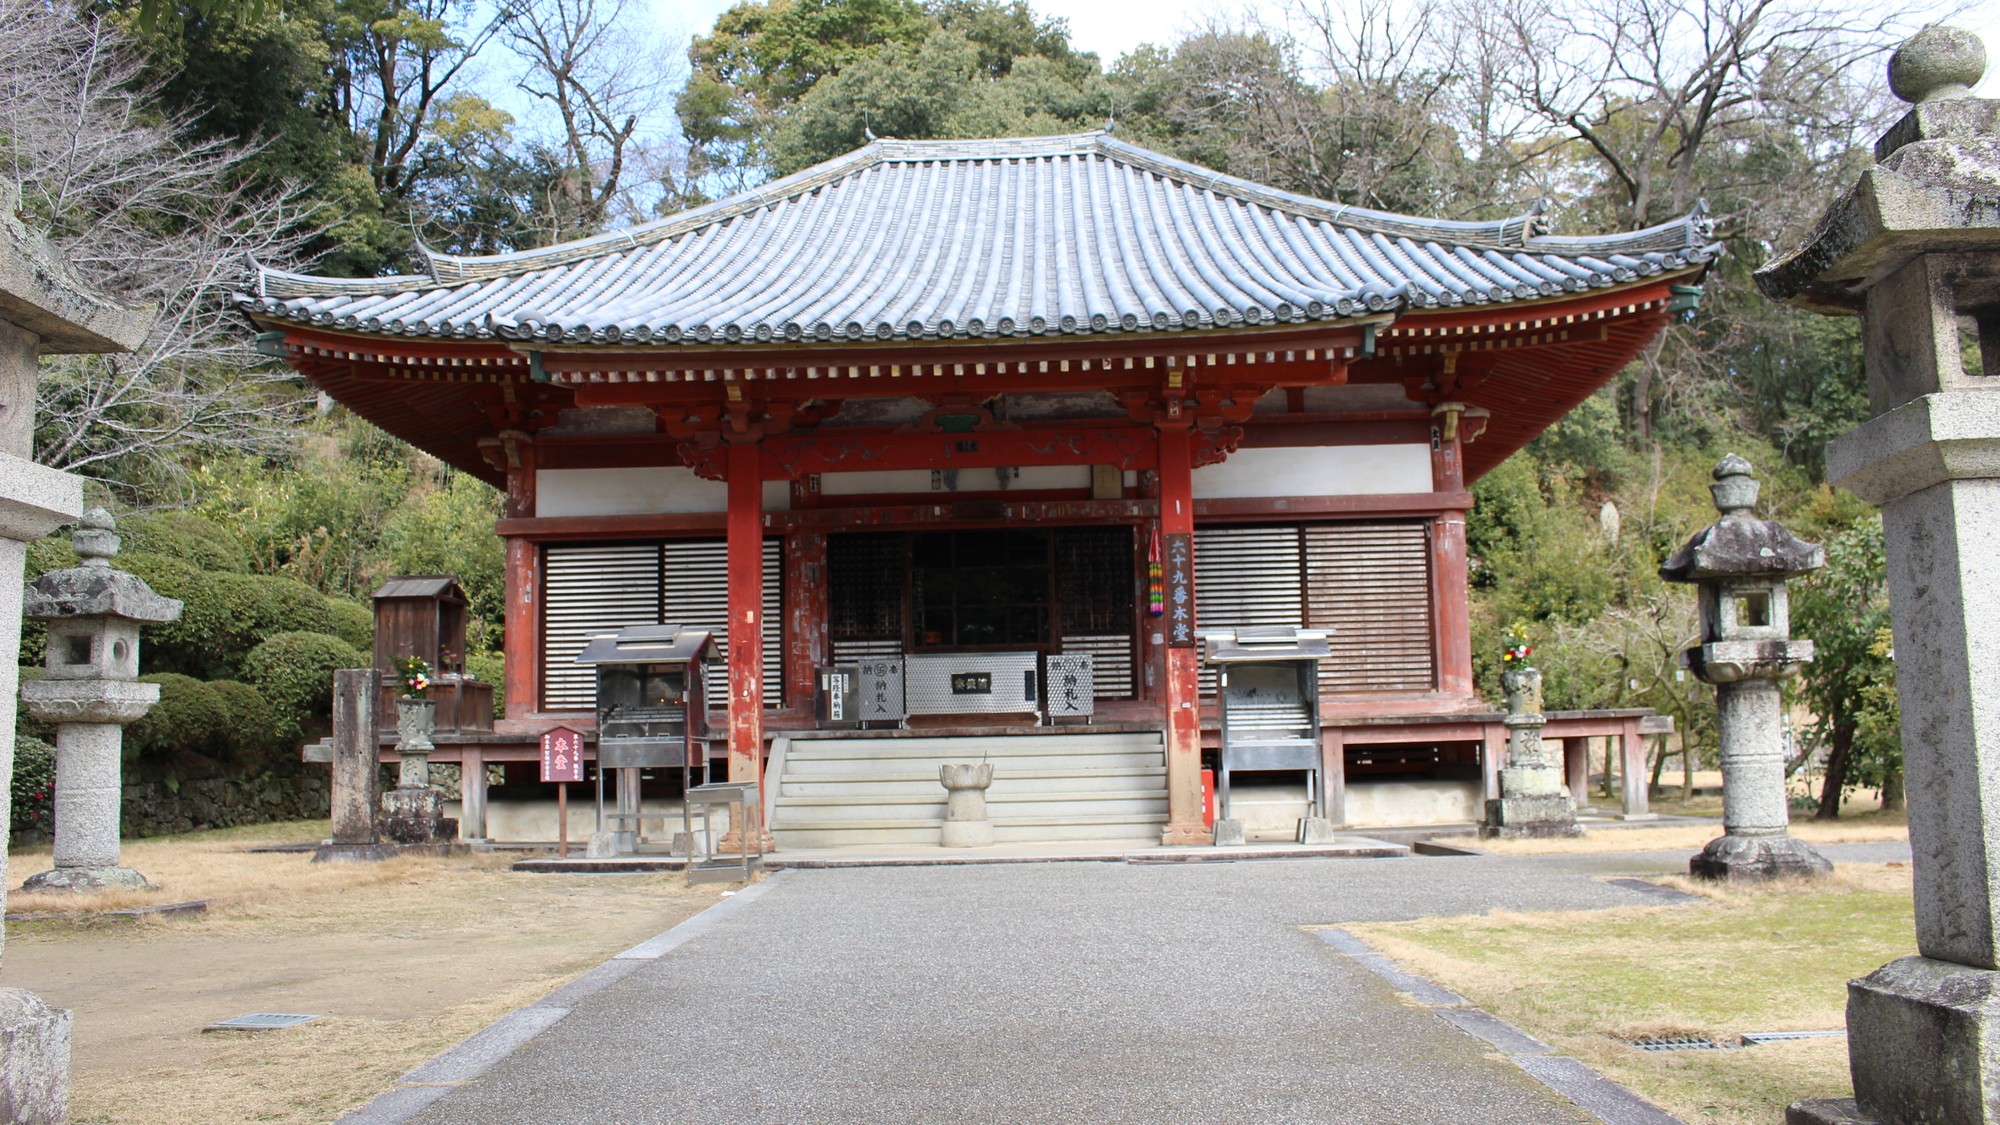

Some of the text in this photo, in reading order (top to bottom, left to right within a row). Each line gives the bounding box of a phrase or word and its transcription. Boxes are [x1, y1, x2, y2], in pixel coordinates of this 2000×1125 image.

[1171, 540, 1189, 641] 六十九番本堂
[875, 680, 887, 713] 納札入
[1063, 674, 1078, 710] 納札入
[554, 737, 569, 770] 本堂
